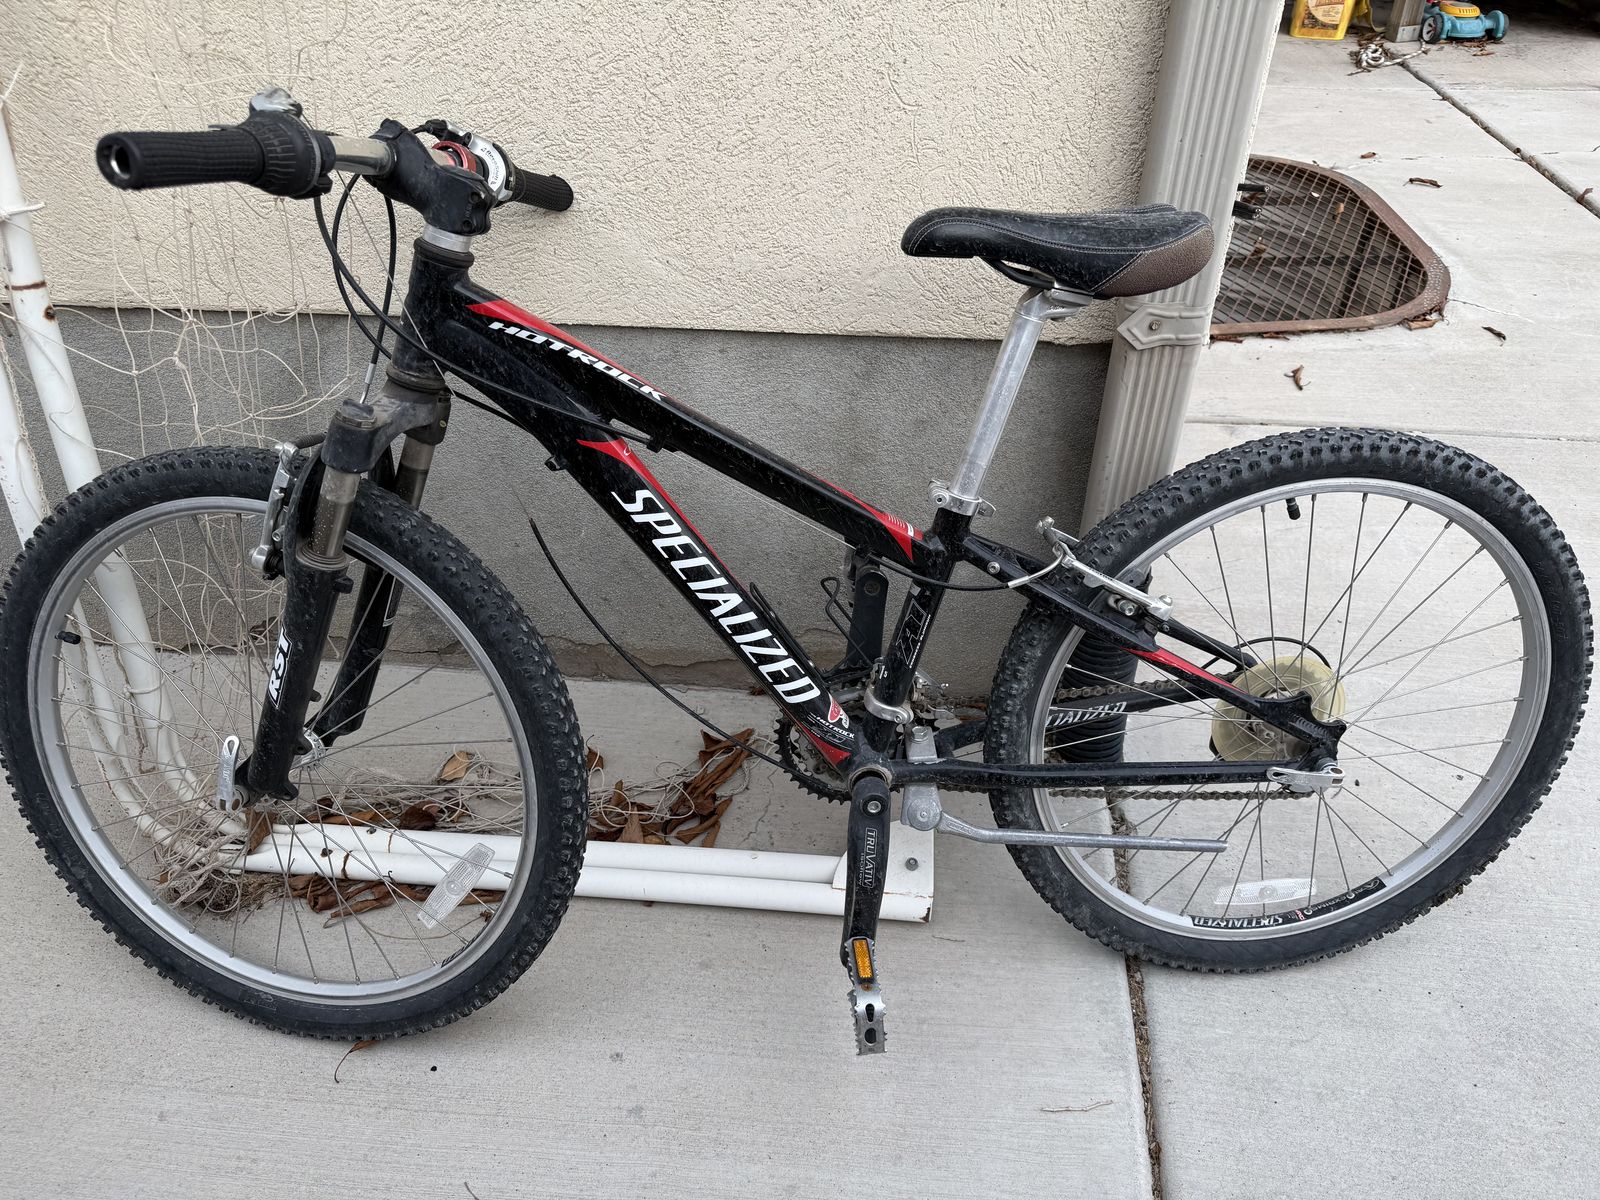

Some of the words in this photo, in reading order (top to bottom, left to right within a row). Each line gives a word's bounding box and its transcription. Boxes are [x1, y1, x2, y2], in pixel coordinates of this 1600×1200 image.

[488, 321, 667, 401] HOTROCK
[610, 489, 821, 704] SPECIALIZED
[268, 626, 289, 701] RST
[1046, 701, 1128, 727] CIALIZED
